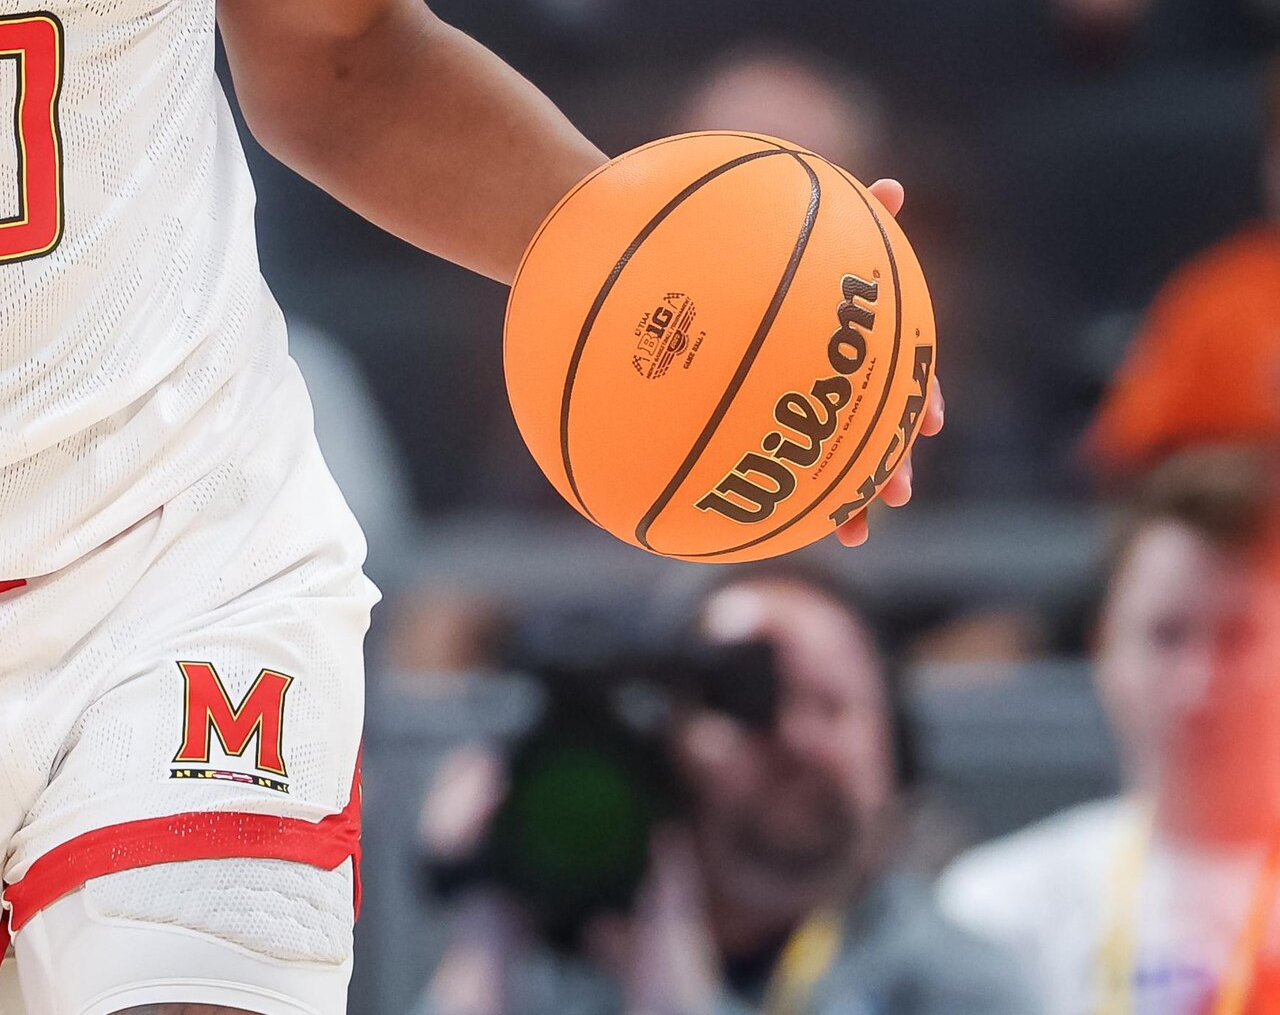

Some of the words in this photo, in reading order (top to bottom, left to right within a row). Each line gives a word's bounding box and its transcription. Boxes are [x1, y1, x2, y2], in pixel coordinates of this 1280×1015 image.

[693, 272, 879, 525] Wilson
[811, 434, 844, 481] INDOOR
[843, 395, 864, 431] GAME
[861, 356, 877, 391] BALL
[828, 344, 933, 527] NCAA
[171, 660, 295, 778] M
